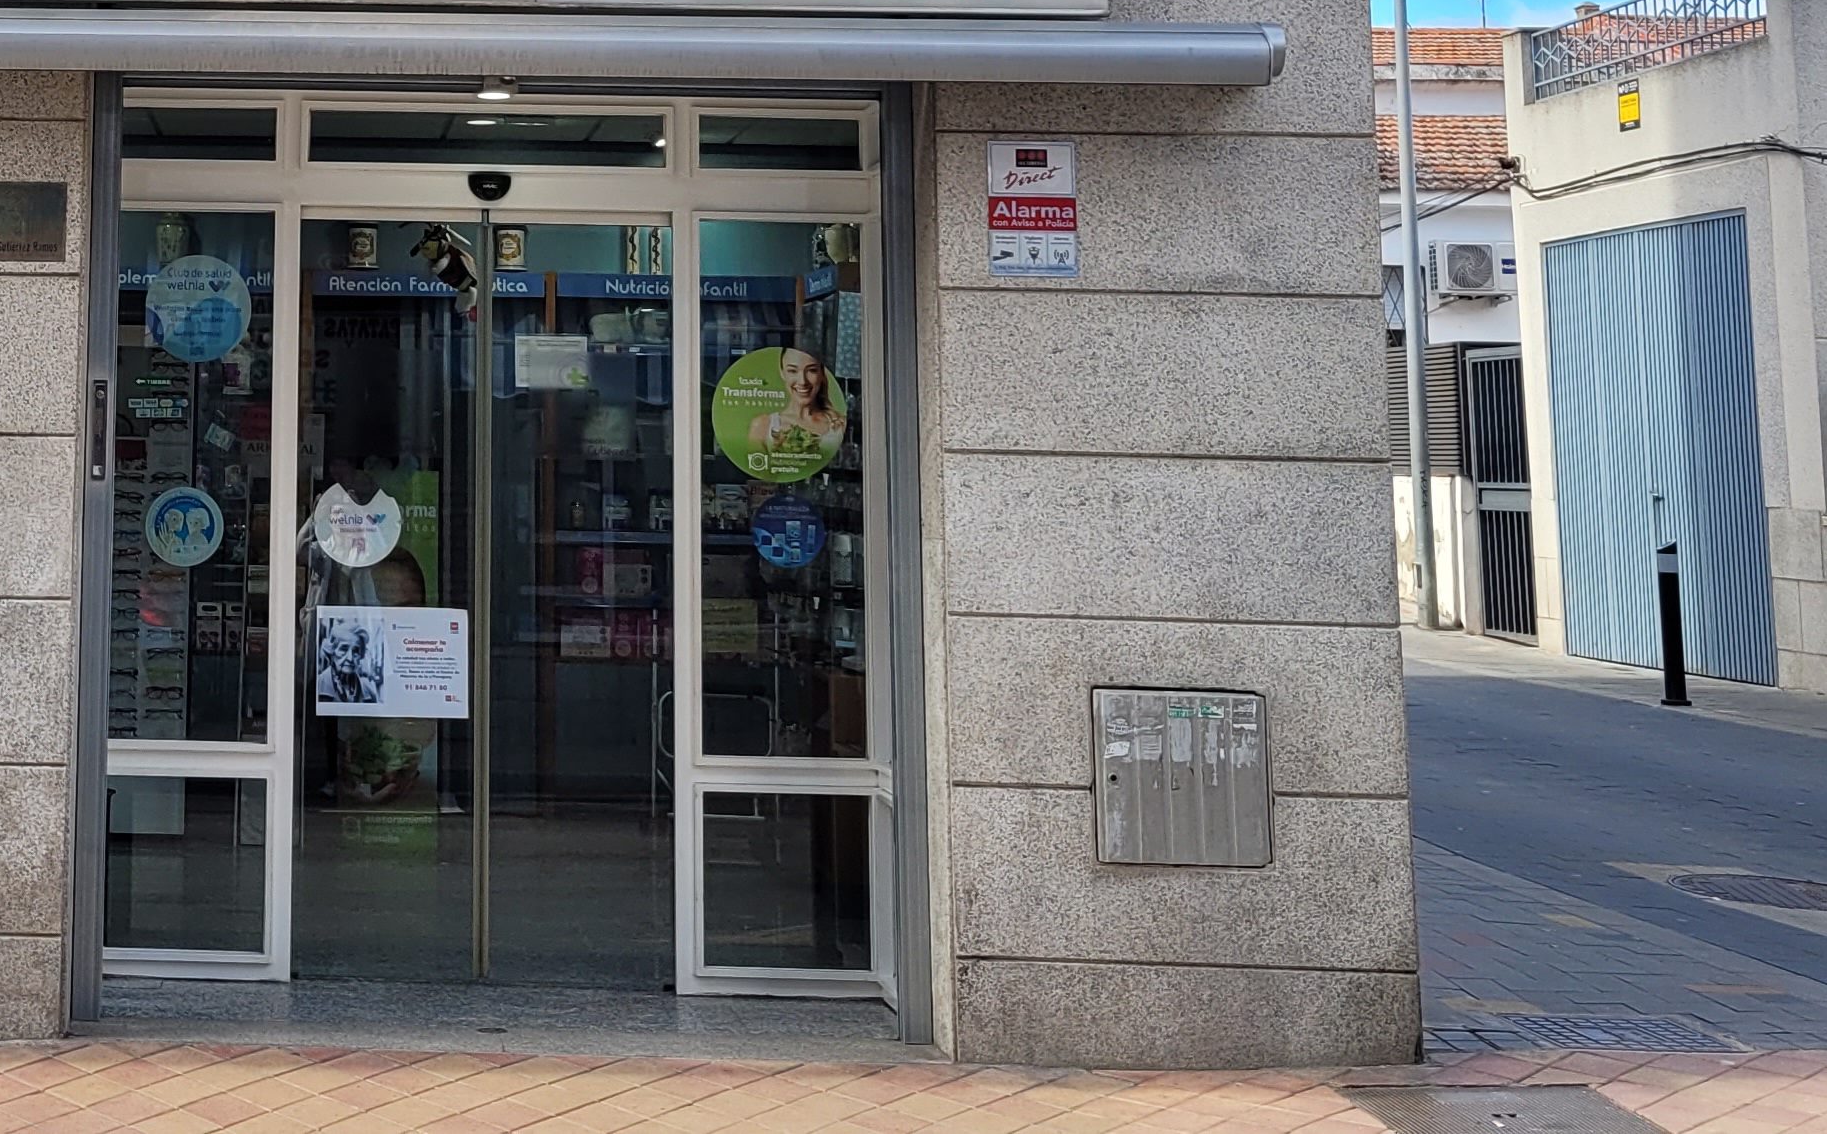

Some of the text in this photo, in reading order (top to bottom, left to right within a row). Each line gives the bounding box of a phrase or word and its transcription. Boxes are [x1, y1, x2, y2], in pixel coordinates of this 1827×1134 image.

[992, 200, 1075, 219] Alarma
[1010, 219, 1036, 227] Aviso
[33, 241, 58, 253] Ramos
[167, 268, 232, 279] Club de salud
[166, 279, 205, 291] welnia
[328, 275, 402, 292] Atención
[605, 278, 673, 296] Nutrició
[721, 386, 786, 399] Transforma
[329, 513, 364, 525] welnia
